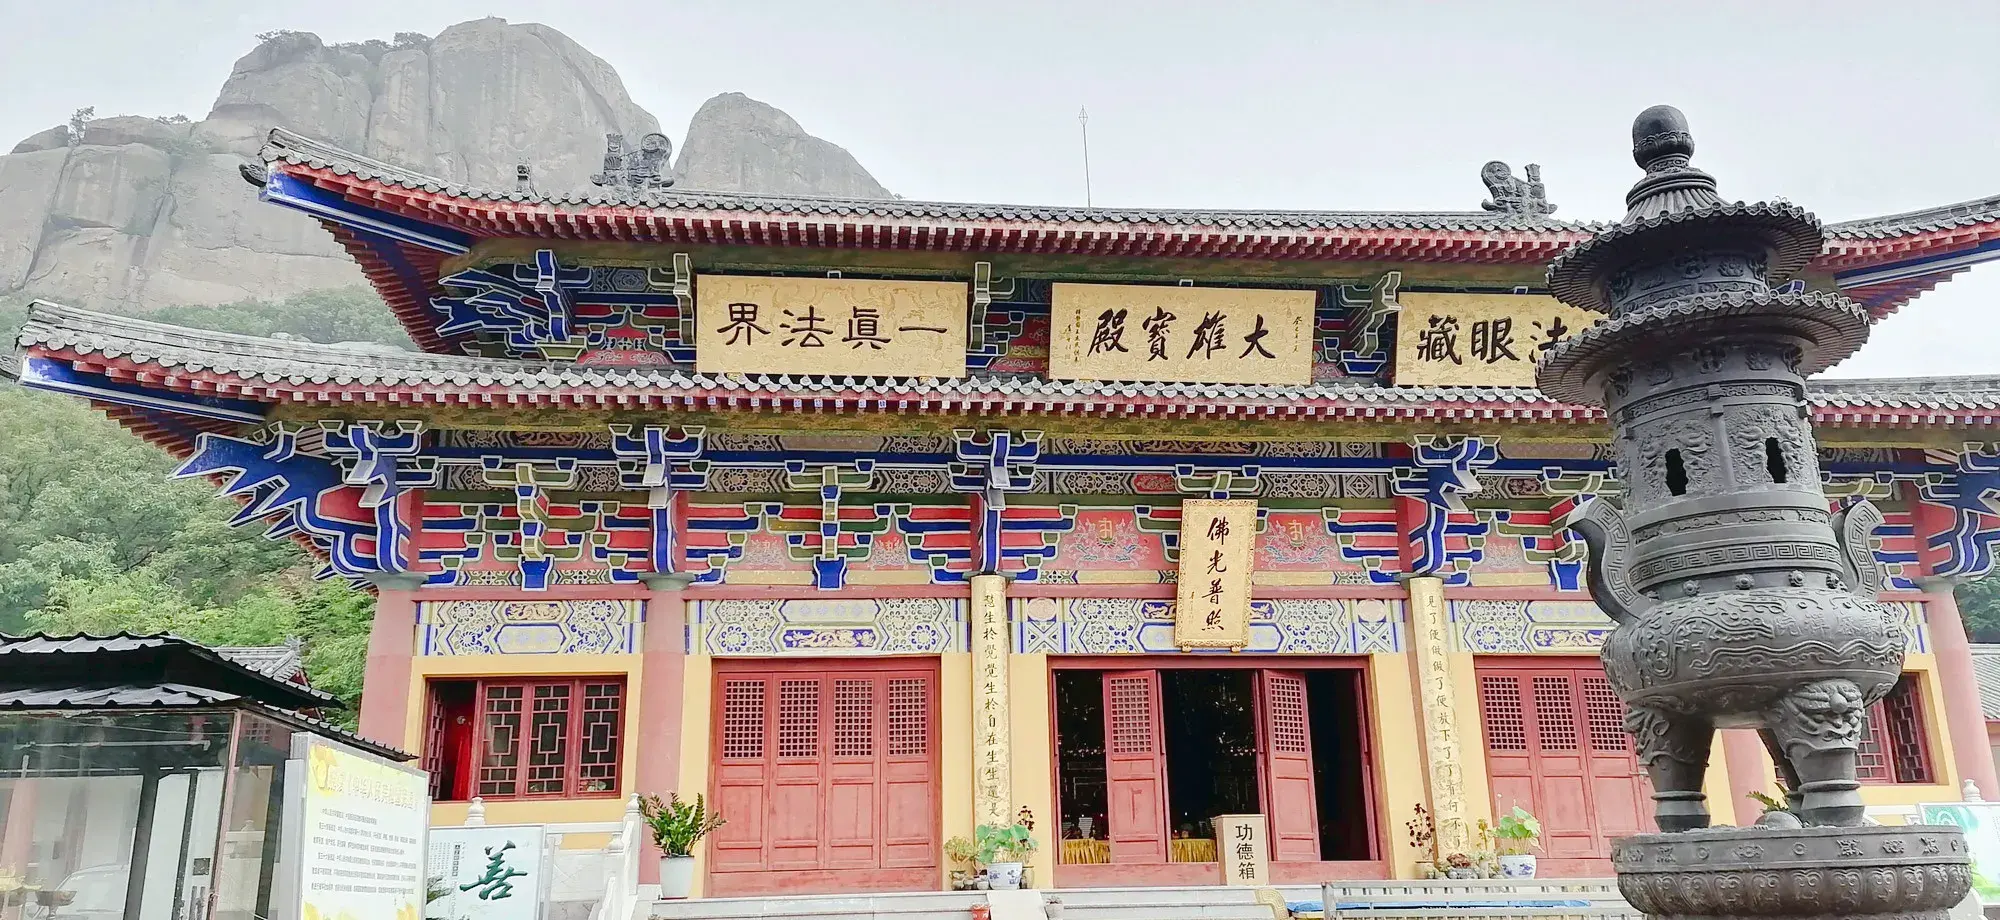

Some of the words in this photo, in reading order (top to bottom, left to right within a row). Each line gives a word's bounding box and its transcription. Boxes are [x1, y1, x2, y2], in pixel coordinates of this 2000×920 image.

[1416, 314, 1601, 366] 法眼藏
[1201, 516, 1231, 631] 佛光普照
[459, 839, 528, 901] 善
[1235, 823, 1256, 880] 功德箱
